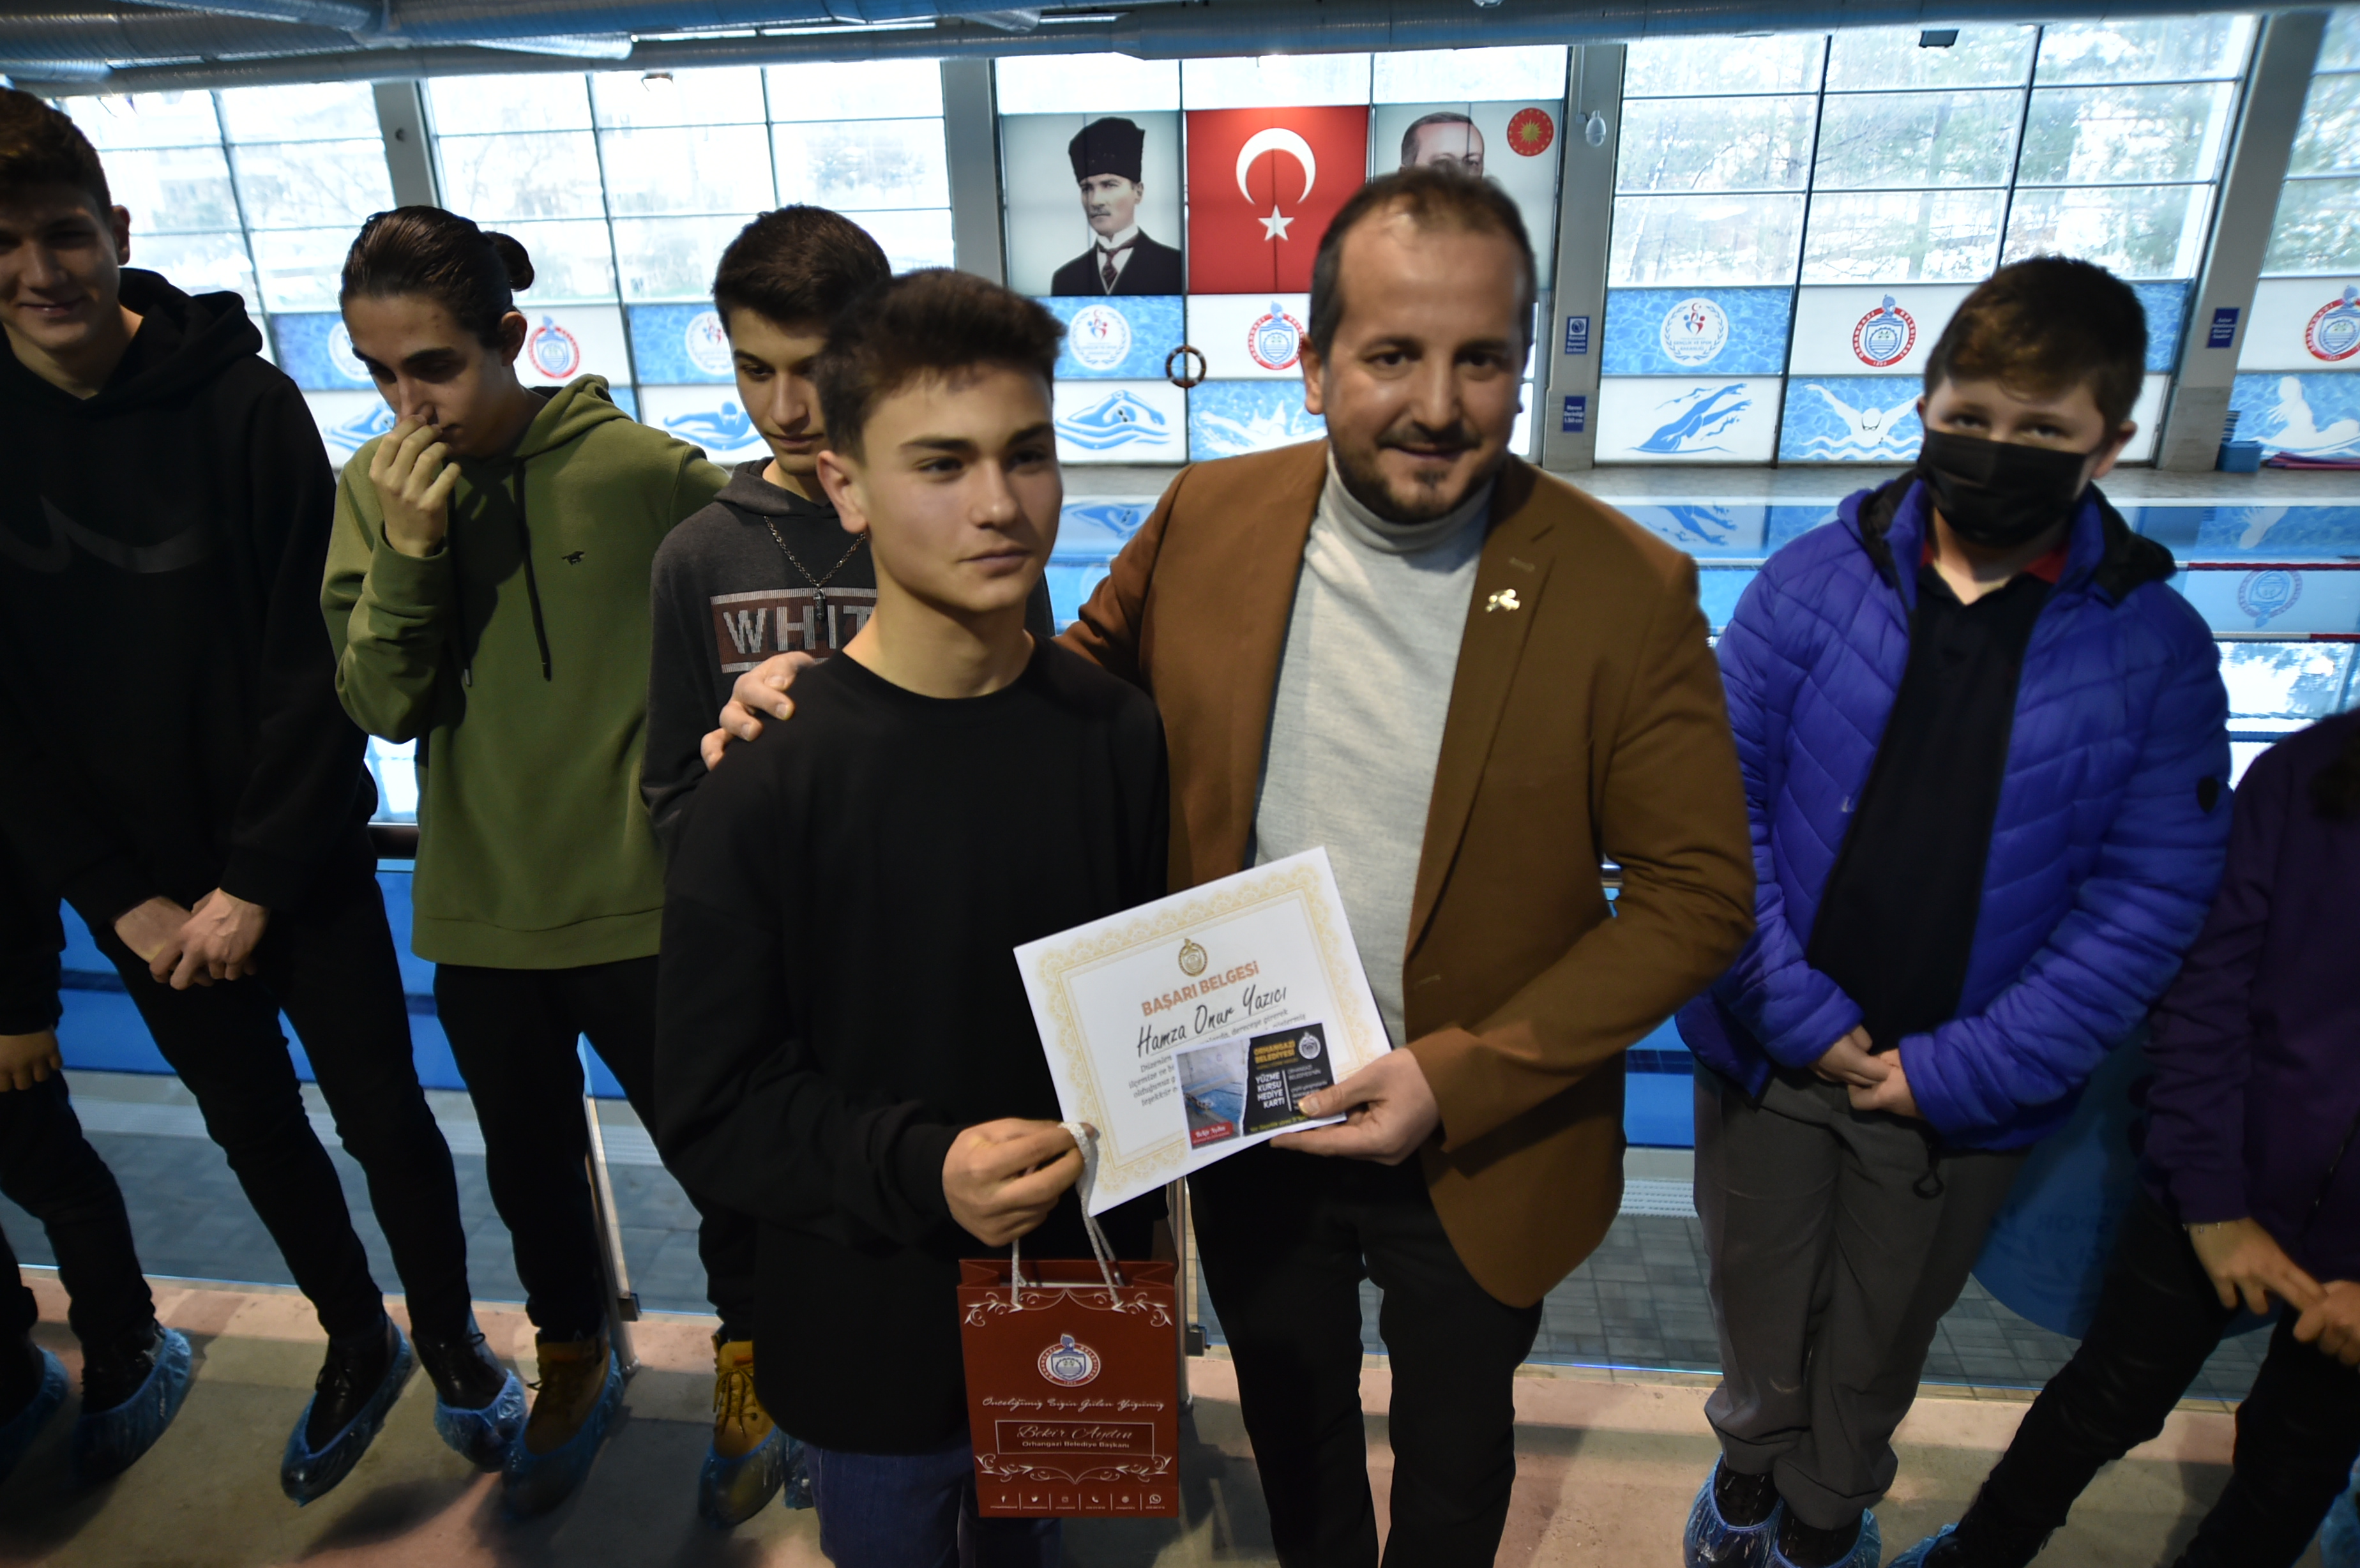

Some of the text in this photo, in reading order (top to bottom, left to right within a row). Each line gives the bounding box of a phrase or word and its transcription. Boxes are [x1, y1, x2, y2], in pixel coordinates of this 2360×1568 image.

[1142, 961, 1260, 1016] BAŞARI BELGESİ
[1137, 984, 1287, 1058] Hamza Onur Yazıcı
[1255, 1072, 1281, 1084] YÜZME
[1257, 1081, 1282, 1093] KURSU
[1257, 1089, 1283, 1101] HEDİYE
[1263, 1097, 1285, 1109] KARTI
[1078, 1398, 1113, 1412] Gülen
[1017, 1425, 1133, 1441] Bekir Aydın
